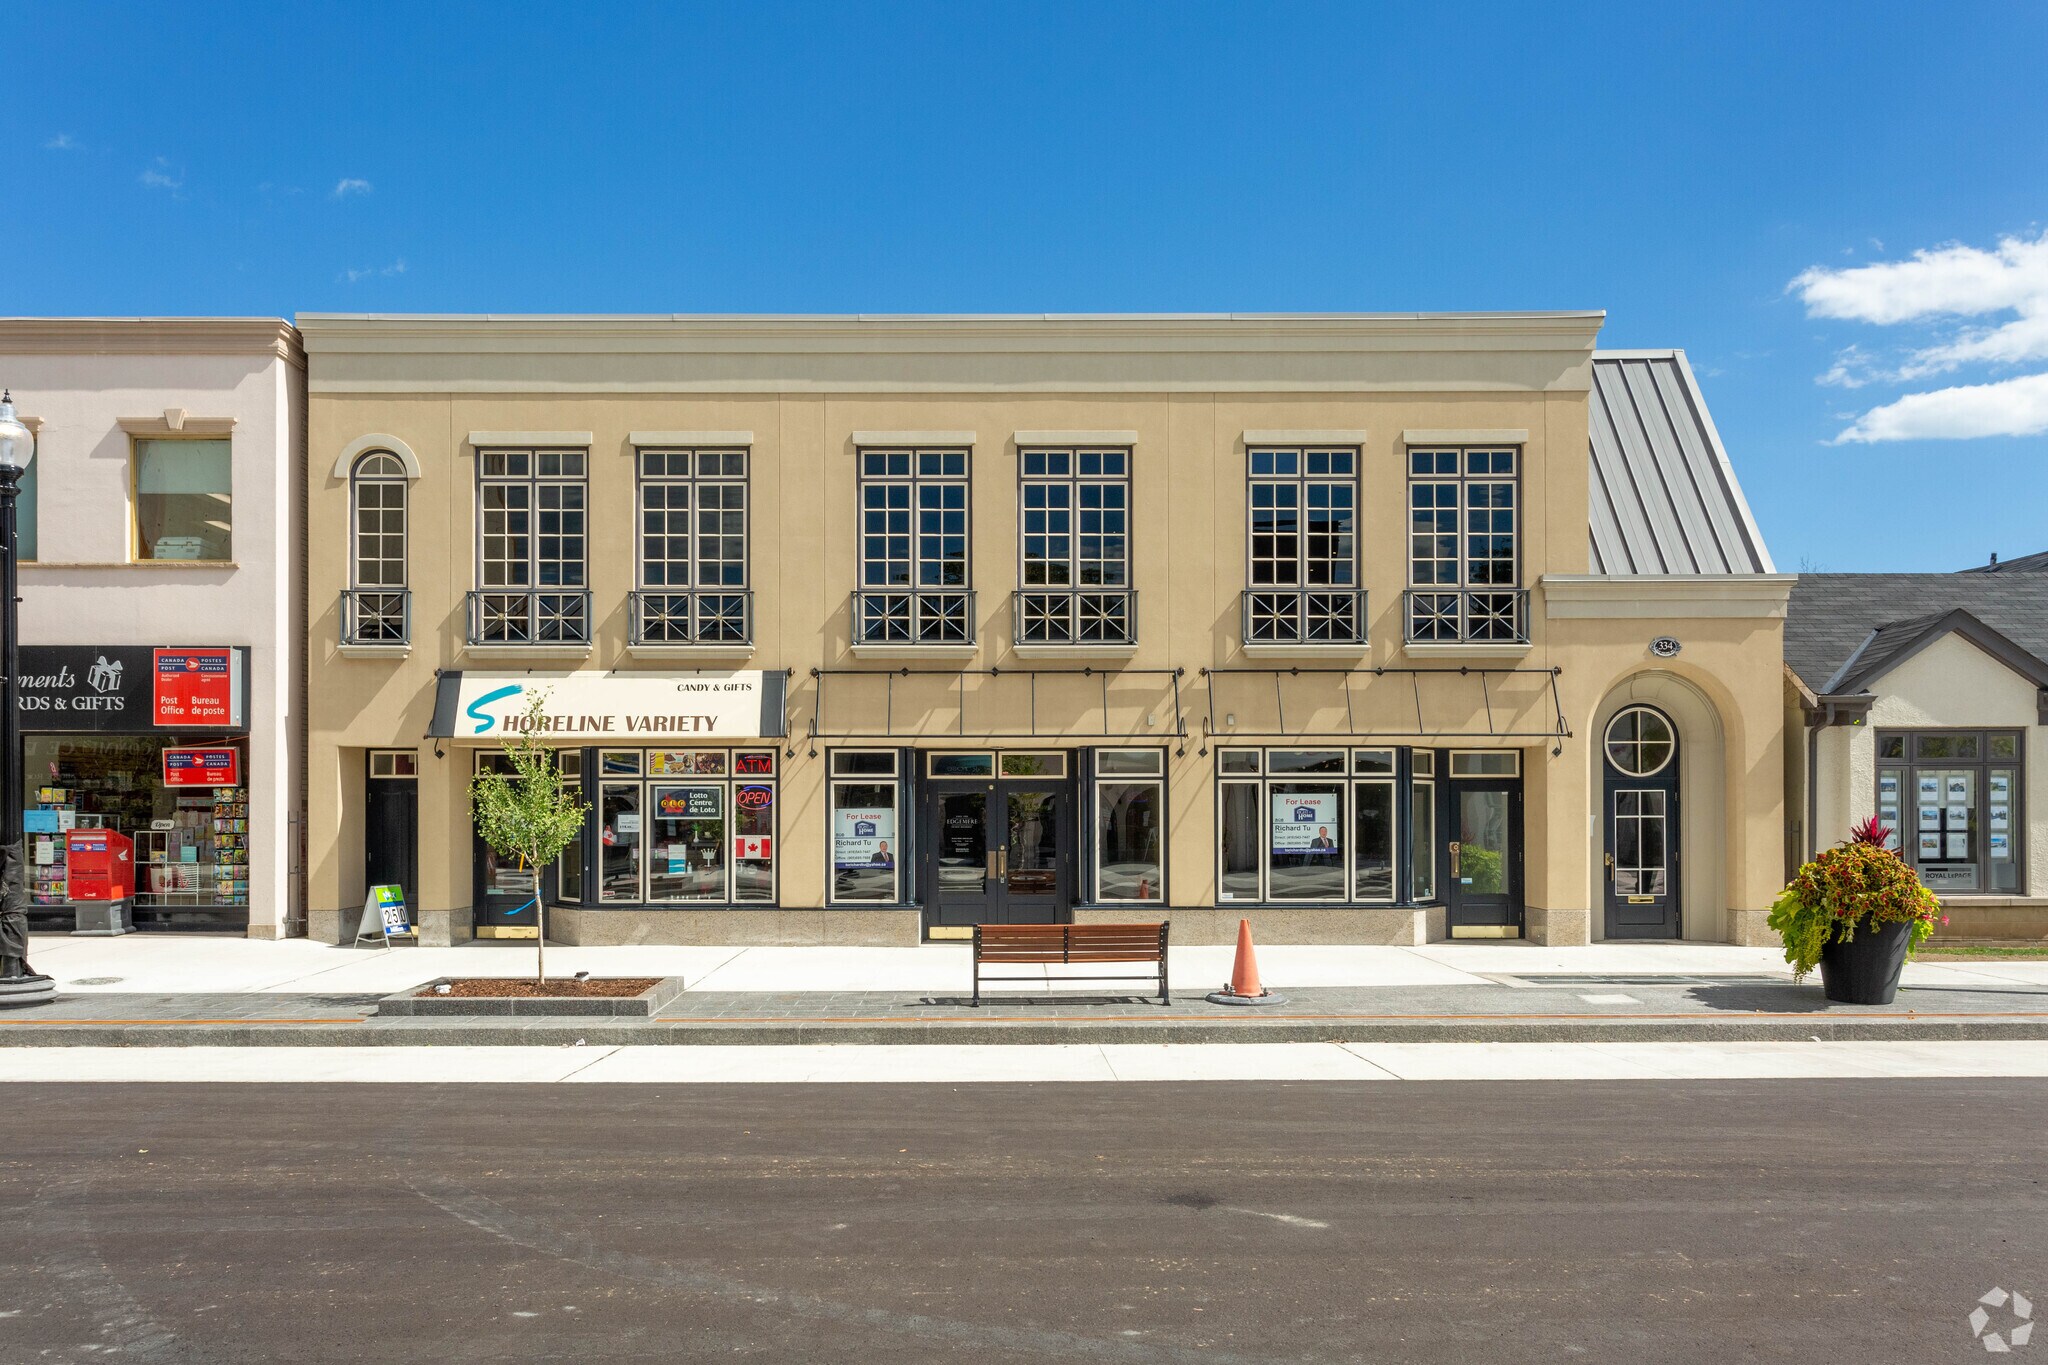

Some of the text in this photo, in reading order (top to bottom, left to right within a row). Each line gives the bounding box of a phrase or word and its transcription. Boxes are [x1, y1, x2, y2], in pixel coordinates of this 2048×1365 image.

[1658, 641, 1673, 650] 334
[677, 684, 710, 692] CANDY
[724, 683, 752, 691] GIFTS
[54, 697, 67, 710] &
[72, 696, 125, 710] GIFTS
[161, 696, 178, 704] Post
[192, 696, 219, 704] Bureau
[161, 706, 184, 714] Office
[192, 706, 224, 716] de poste
[625, 715, 718, 732] VARIETY
[736, 760, 771, 773] ATM
[739, 792, 771, 804] OPEN
